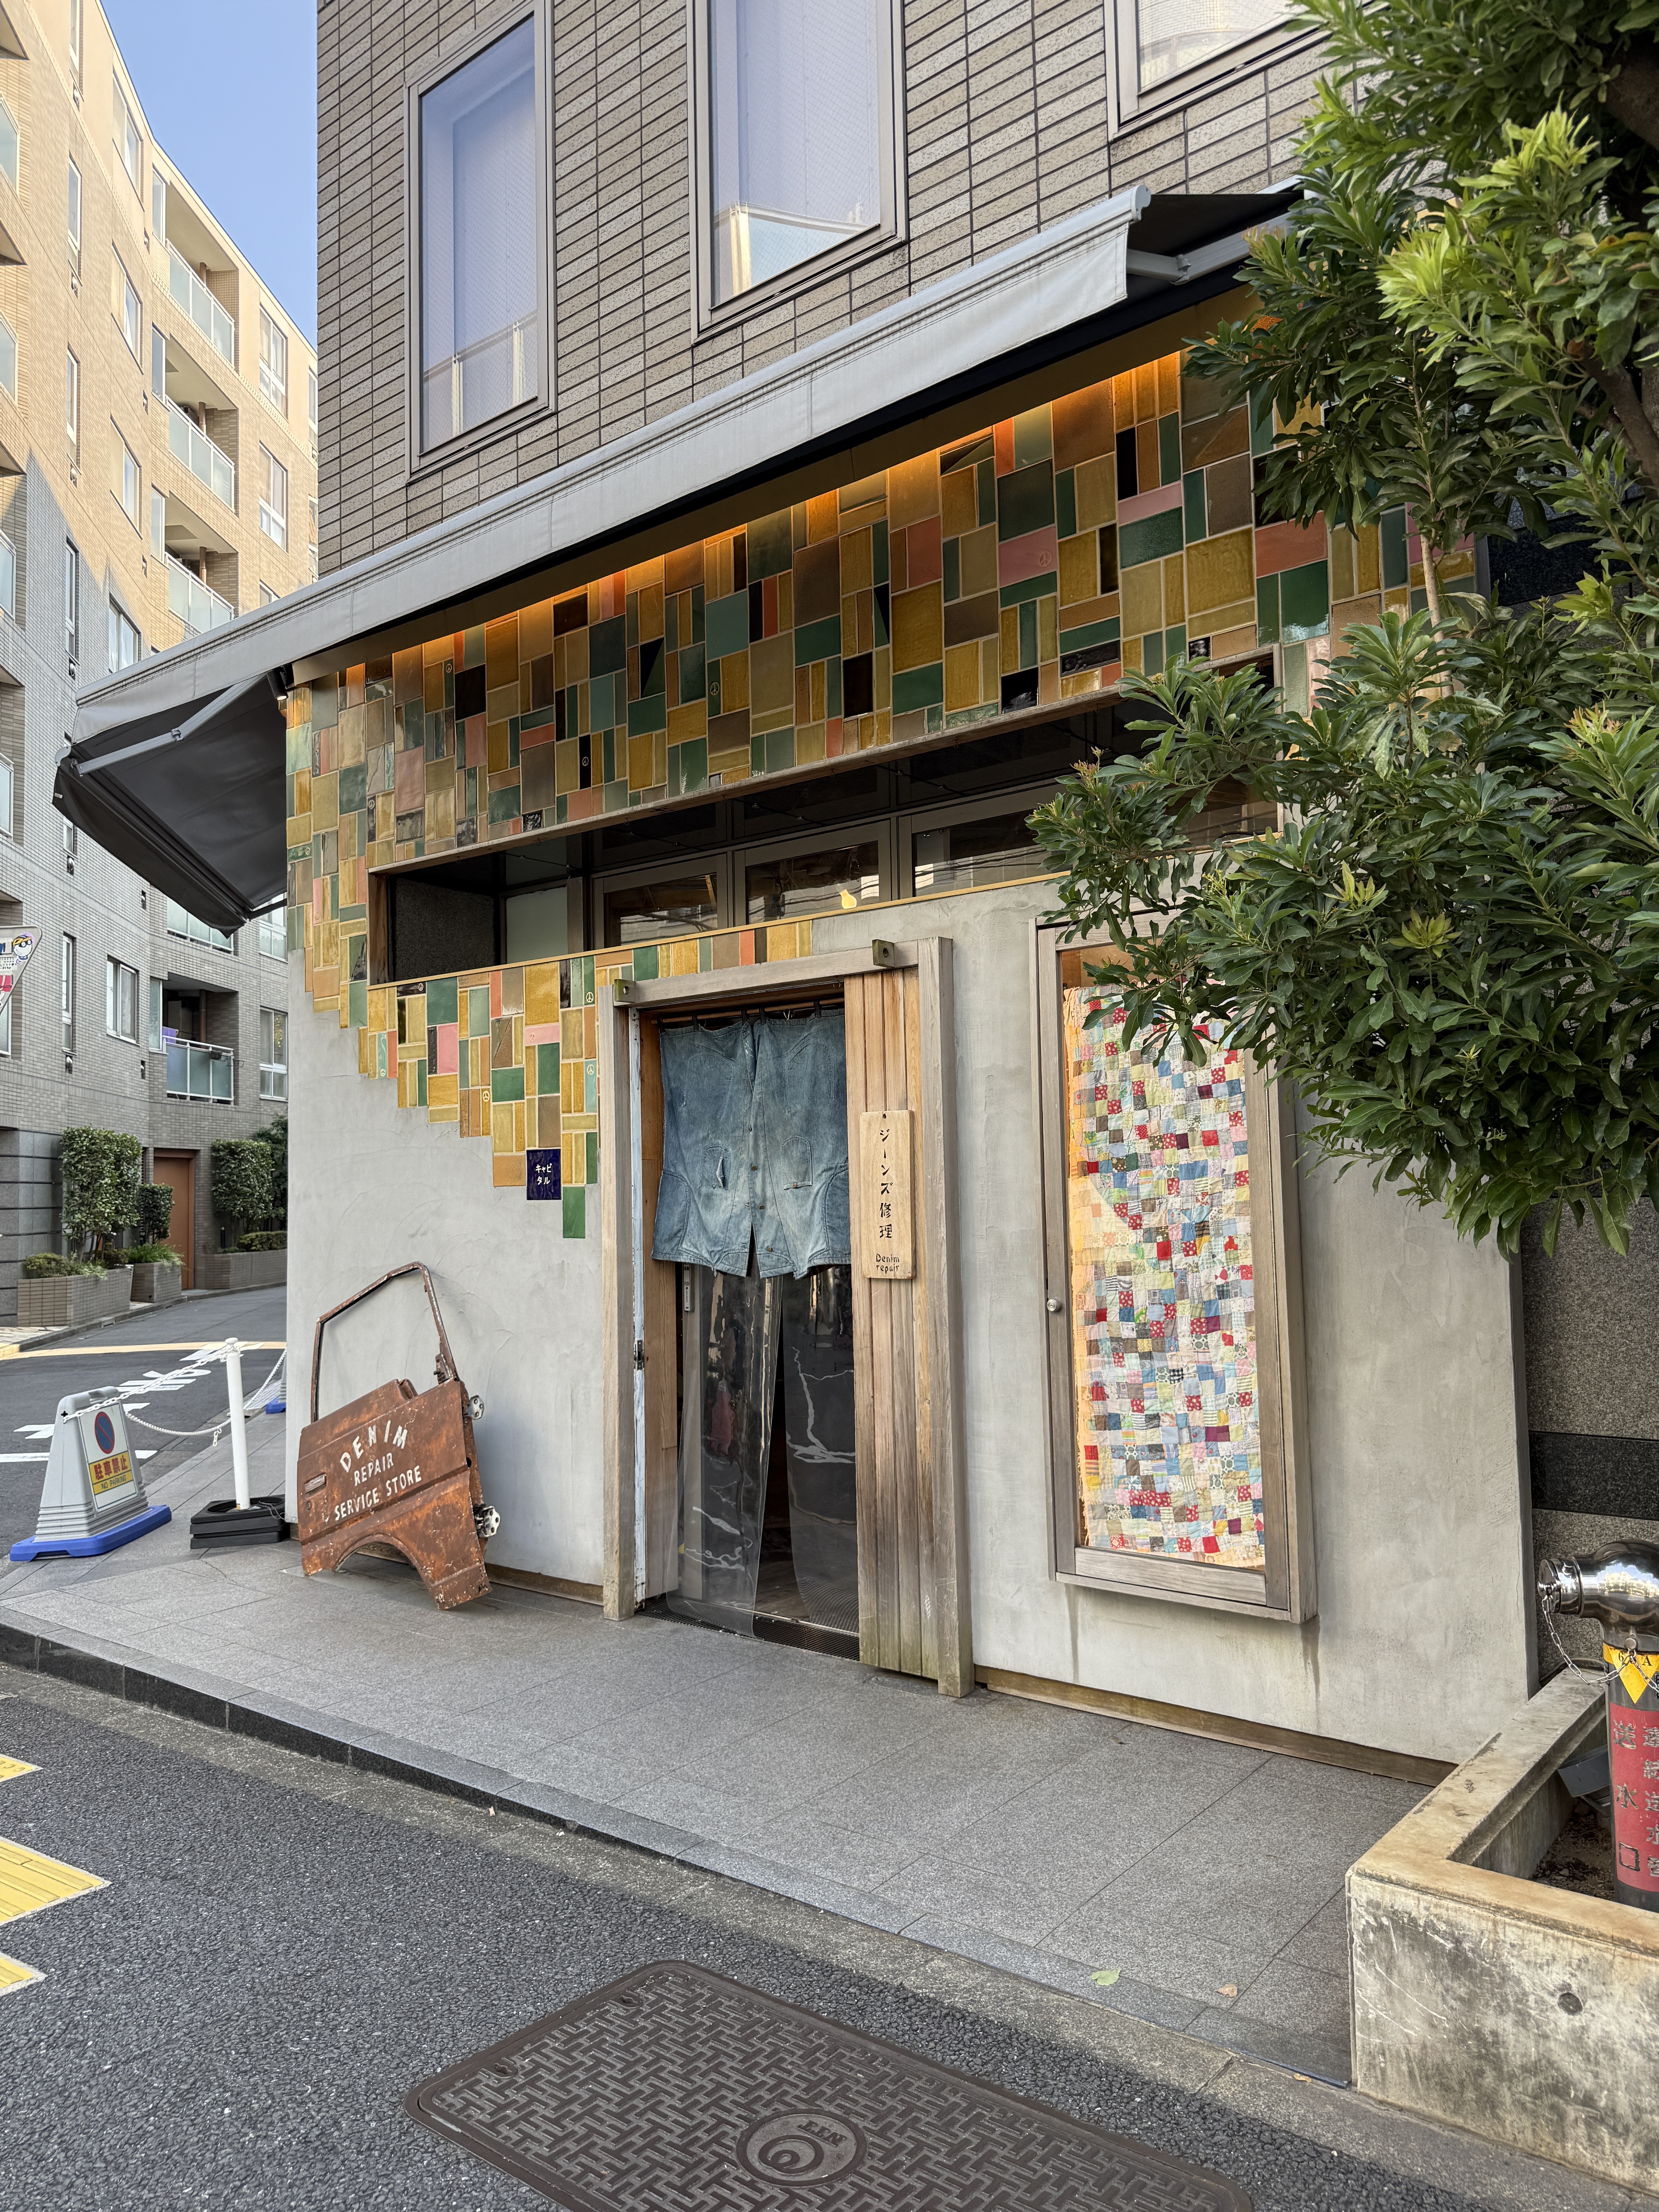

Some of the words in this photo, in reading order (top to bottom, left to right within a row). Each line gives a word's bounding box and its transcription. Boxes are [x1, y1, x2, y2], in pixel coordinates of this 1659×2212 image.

[536, 1163, 552, 1173] キャピ
[537, 1176, 550, 1185] タル
[879, 1128, 893, 1238] ジーンズ修理
[876, 1253, 899, 1262] Denim
[876, 1263, 899, 1274] repair
[340, 1420, 408, 1473] DENIM
[94, 1455, 128, 1480] 駐車禁止
[354, 1452, 394, 1487] REPAIR
[109, 1475, 126, 1487] PARKING
[335, 1487, 380, 1521] SERVICE
[386, 1465, 422, 1497] STORE
[1618, 1651, 1652, 1666] 6A
[1613, 1717, 1640, 1872] 送水口
[797, 2120, 847, 2147] NTT
